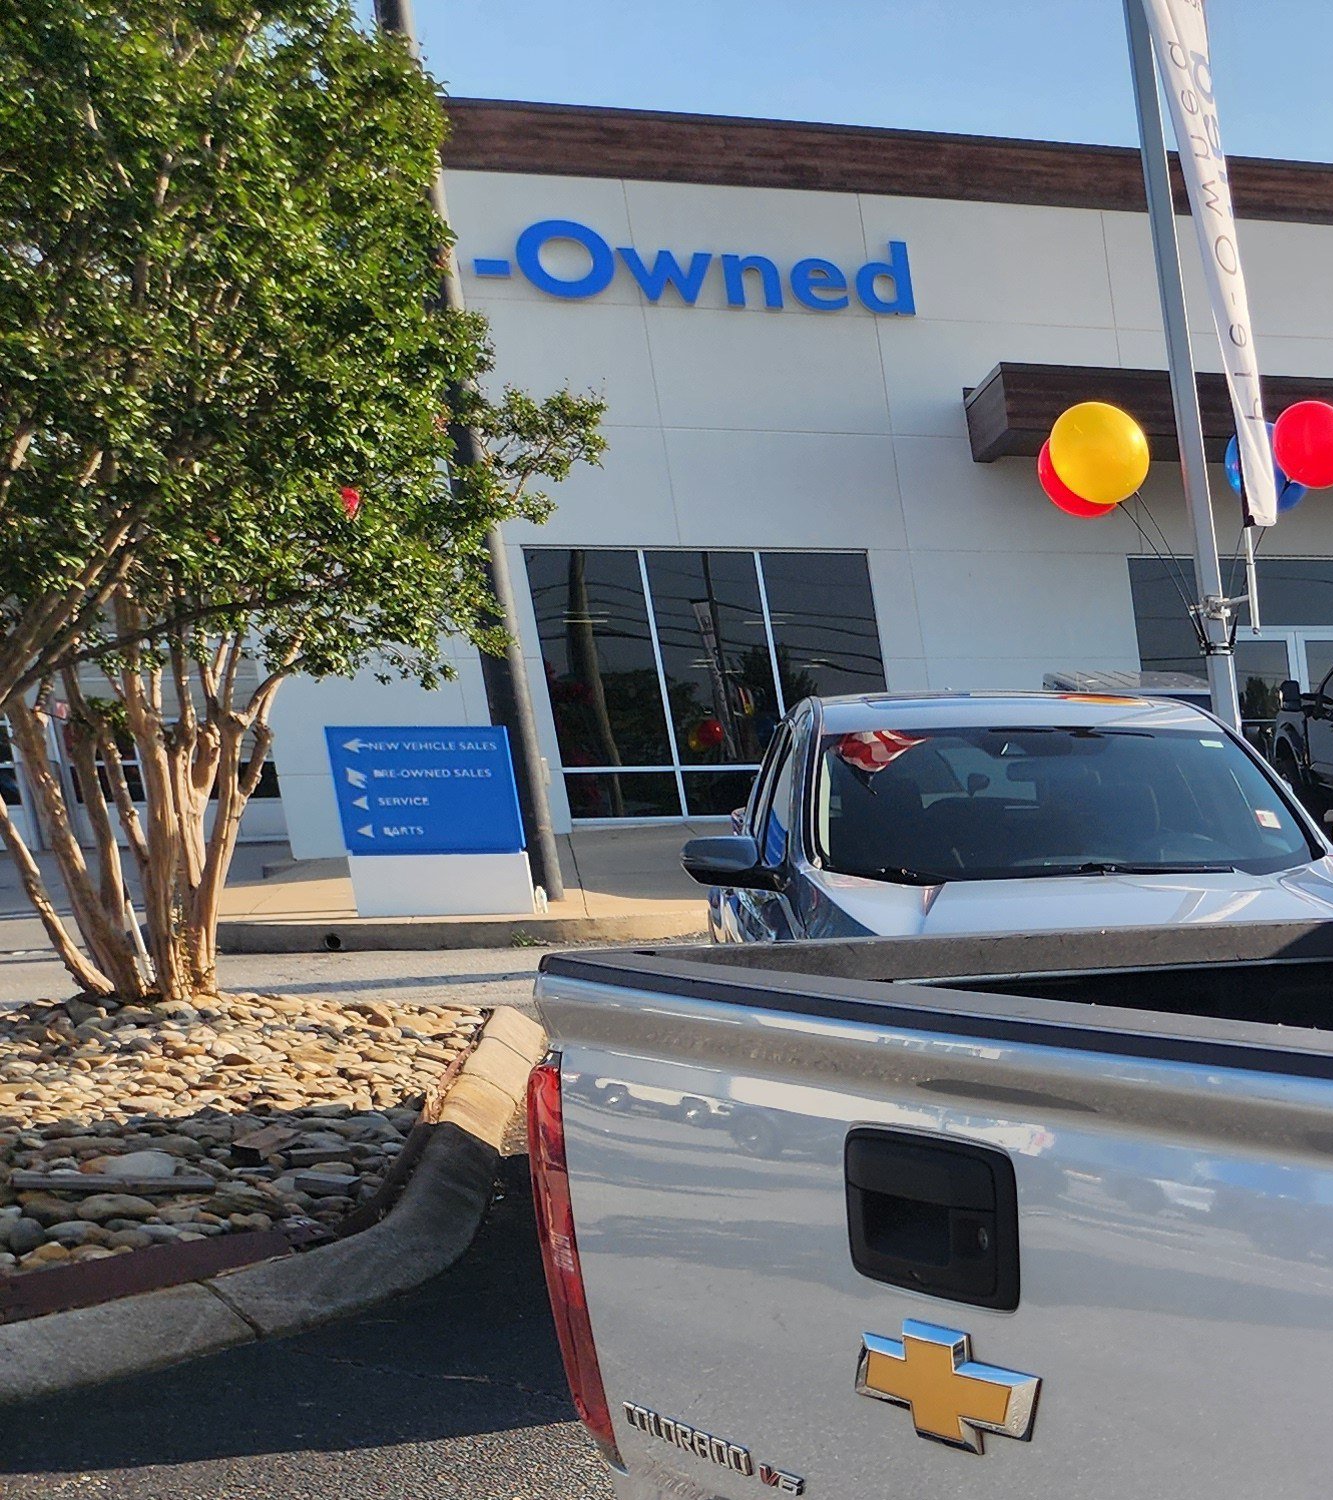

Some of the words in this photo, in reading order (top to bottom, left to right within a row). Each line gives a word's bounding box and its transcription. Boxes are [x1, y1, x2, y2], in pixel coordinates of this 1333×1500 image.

[368, 741, 400, 751] NEW
[402, 741, 456, 751] VEHICLE
[459, 740, 498, 750] SALES
[454, 768, 492, 778] SALES
[378, 796, 430, 807] SERVICE
[759, 1463, 806, 1496] V6
